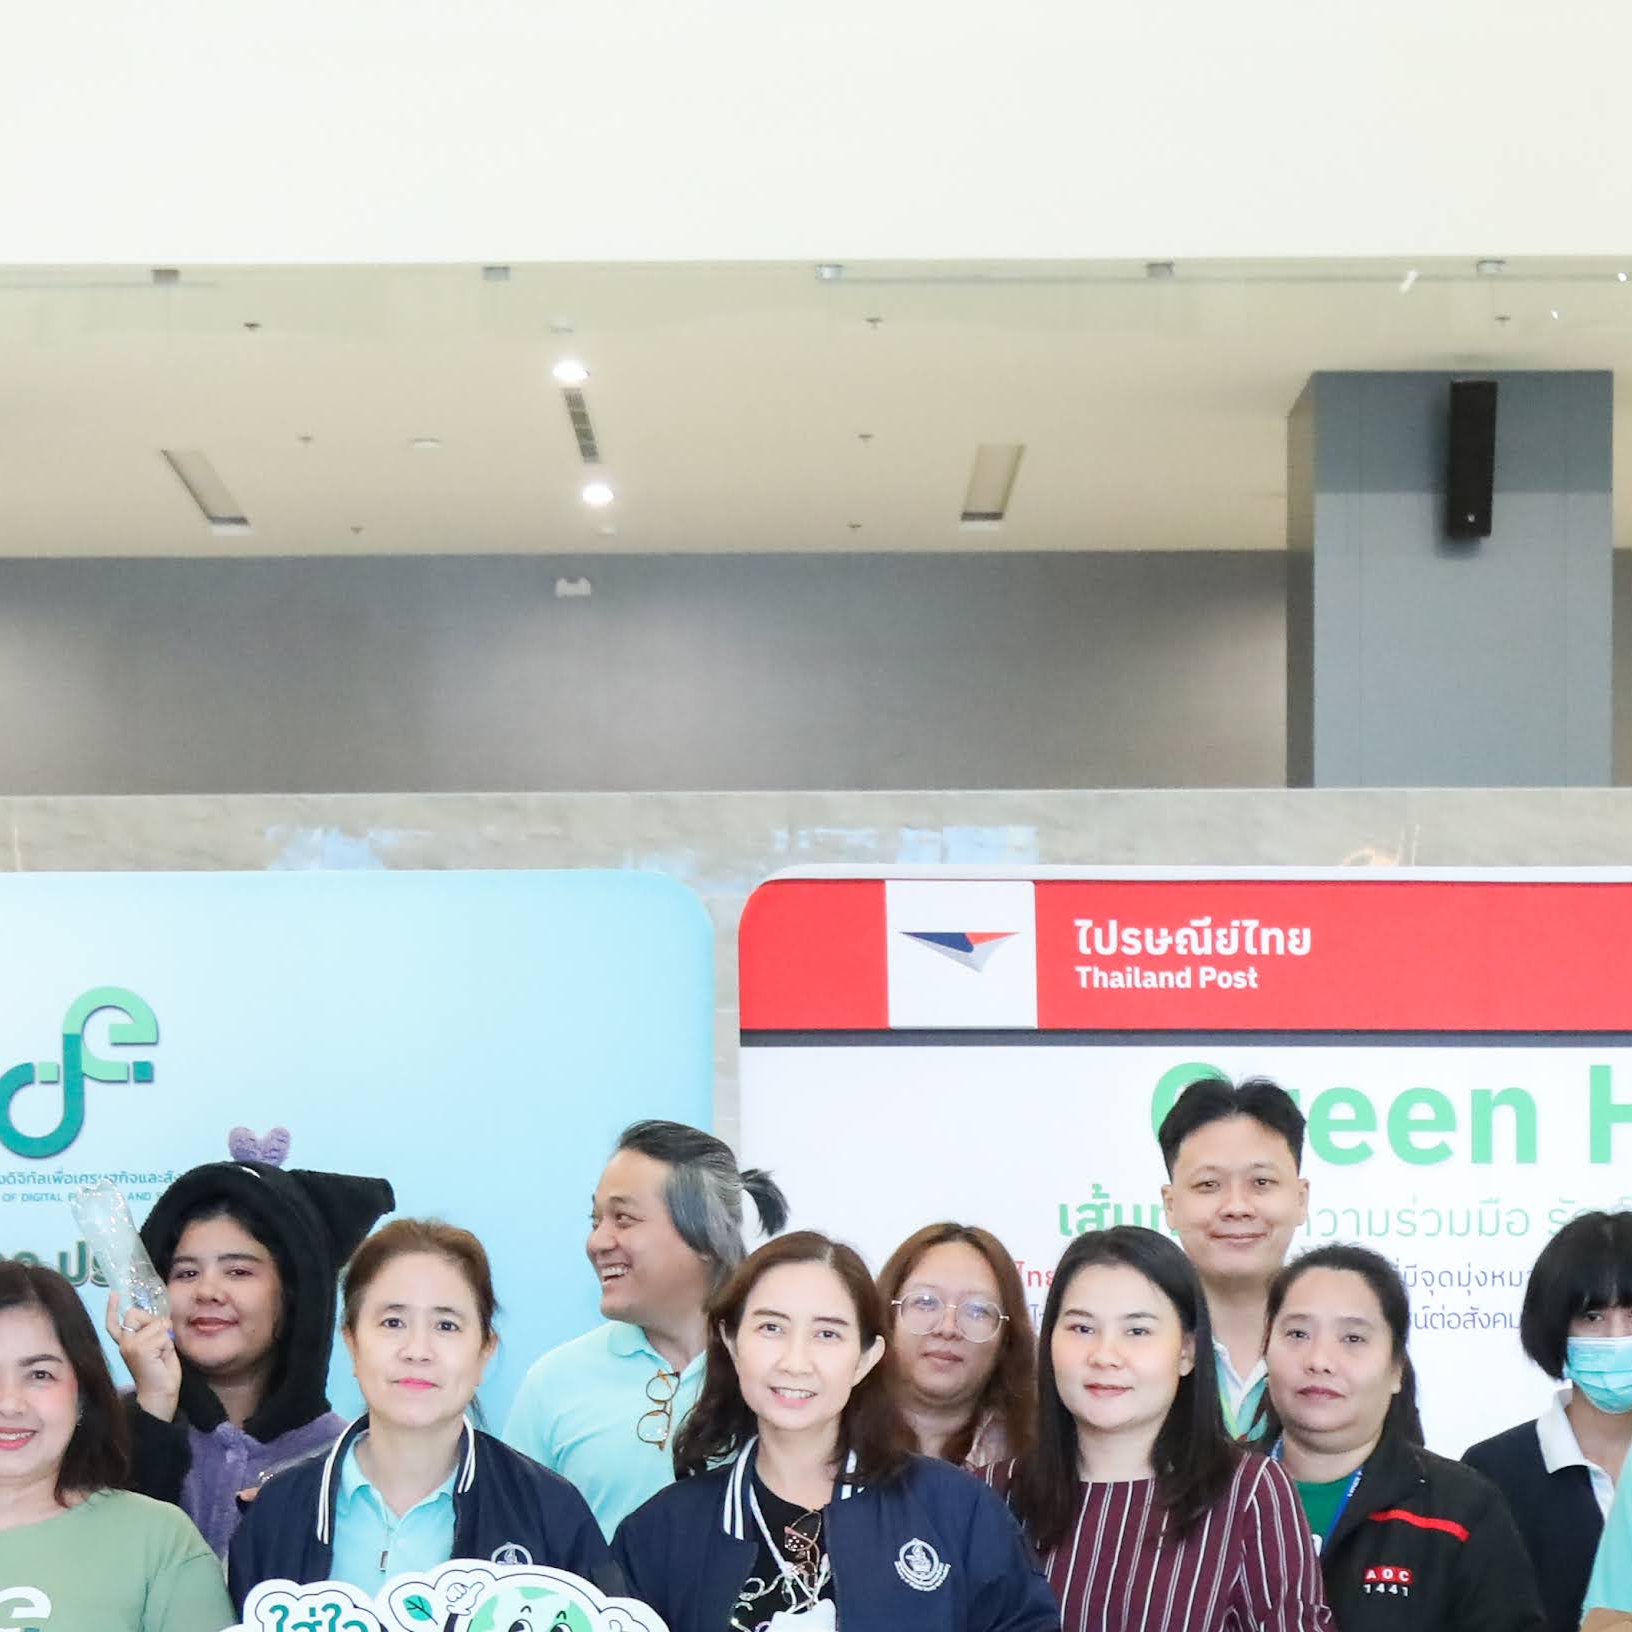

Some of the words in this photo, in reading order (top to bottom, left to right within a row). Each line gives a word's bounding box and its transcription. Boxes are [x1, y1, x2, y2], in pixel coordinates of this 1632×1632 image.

[1073, 915, 1312, 956] ไปรษณีย์ไทย
[1074, 965, 1192, 989] Thailand
[1199, 966, 1258, 989] Post
[1151, 1061, 1537, 1167] een
[1, 1193, 17, 1203] OF
[20, 1192, 62, 1203] DIGITAL
[1303, 1196, 1531, 1237] วามร่วมมือ
[1365, 1568, 1409, 1582] AOC
[1363, 1583, 1408, 1597] 1441
